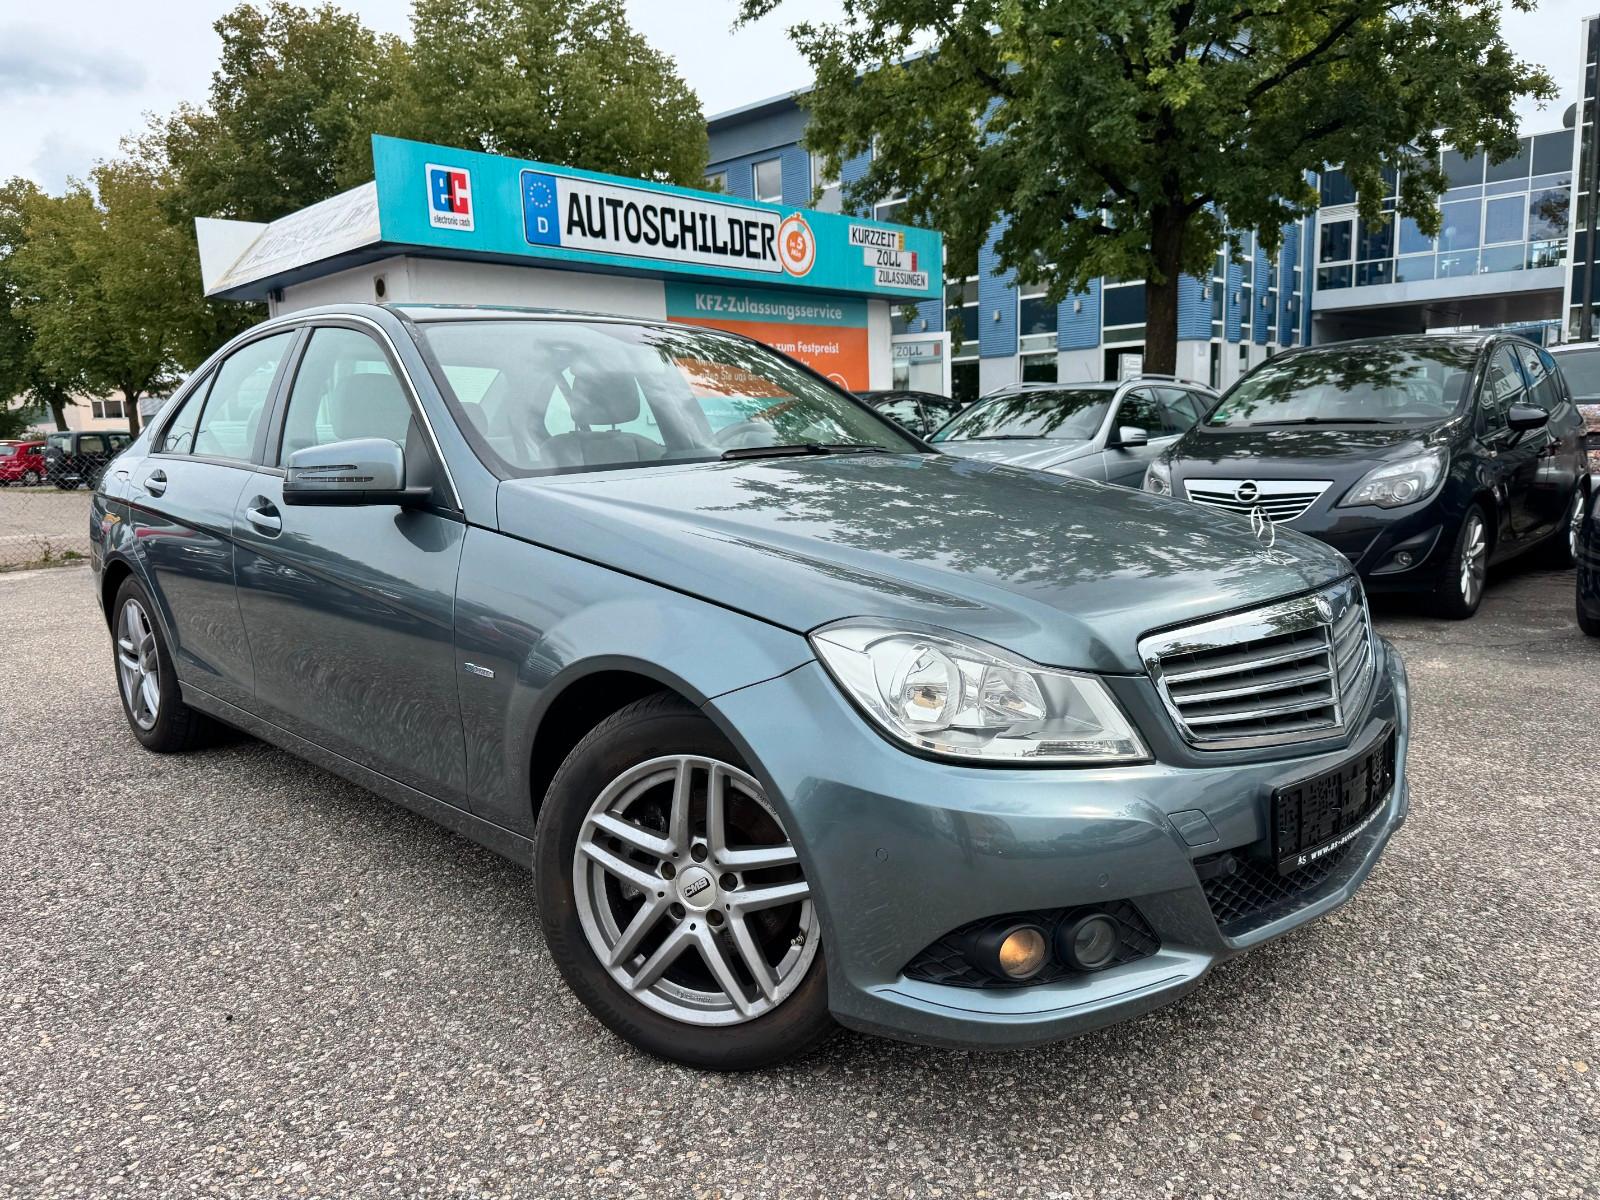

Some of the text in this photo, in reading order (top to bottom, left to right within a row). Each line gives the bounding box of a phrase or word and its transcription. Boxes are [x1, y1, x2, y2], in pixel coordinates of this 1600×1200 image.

[434, 214, 458, 226] electronic
[537, 217, 548, 233] D
[567, 192, 776, 261] AUTOSCHILDER
[796, 237, 803, 250] 5
[852, 227, 896, 248] KURZZEIT
[877, 250, 901, 267] ZOLL
[878, 270, 926, 287] ZULASSUNGEN
[695, 294, 843, 320] KFZ-Zulassungsservice
[797, 341, 839, 356] Festpreis!
[896, 346, 922, 357] ZOLL
